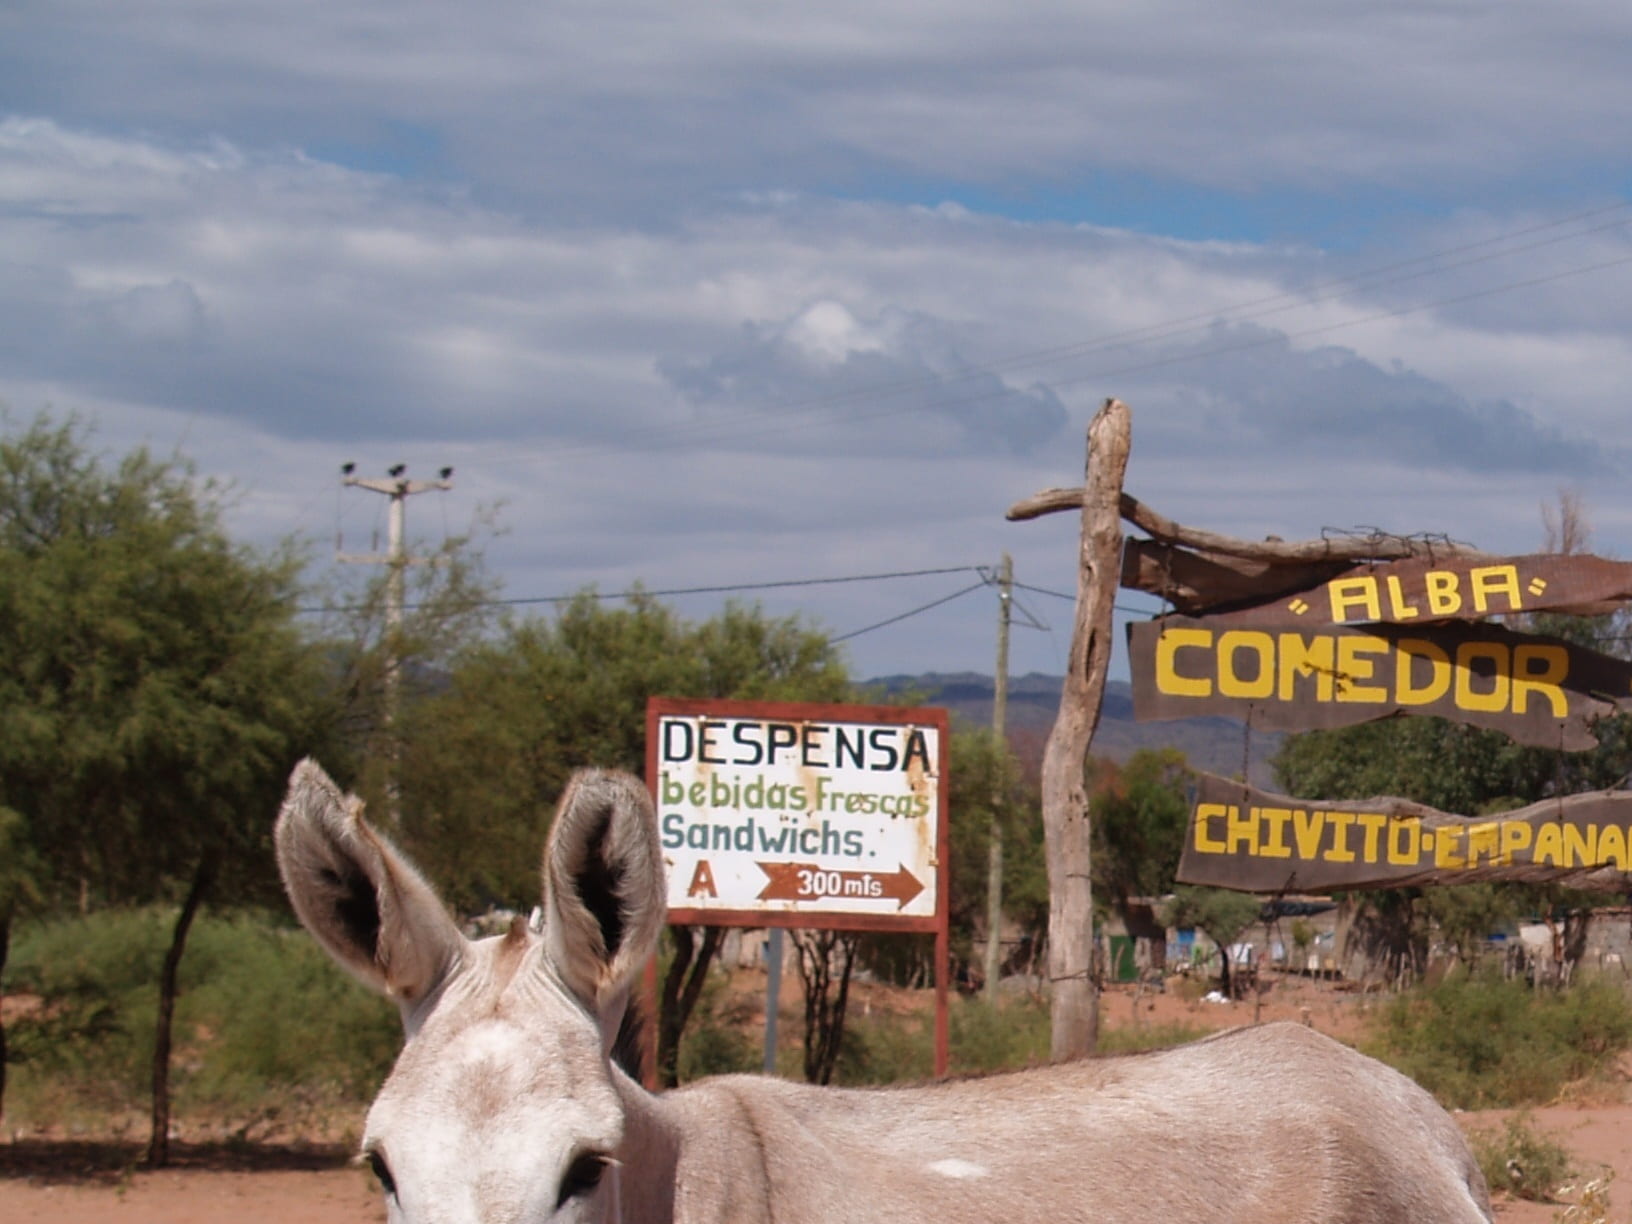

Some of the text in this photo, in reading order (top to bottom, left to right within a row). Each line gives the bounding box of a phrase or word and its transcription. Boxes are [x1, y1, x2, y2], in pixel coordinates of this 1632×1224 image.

[1155, 628, 1569, 718] COMEDOR
[663, 720, 931, 772] DESPENSA
[662, 771, 808, 809] bebidas
[662, 814, 877, 857] Sandwichs.
[688, 860, 883, 898] A 300 mts
